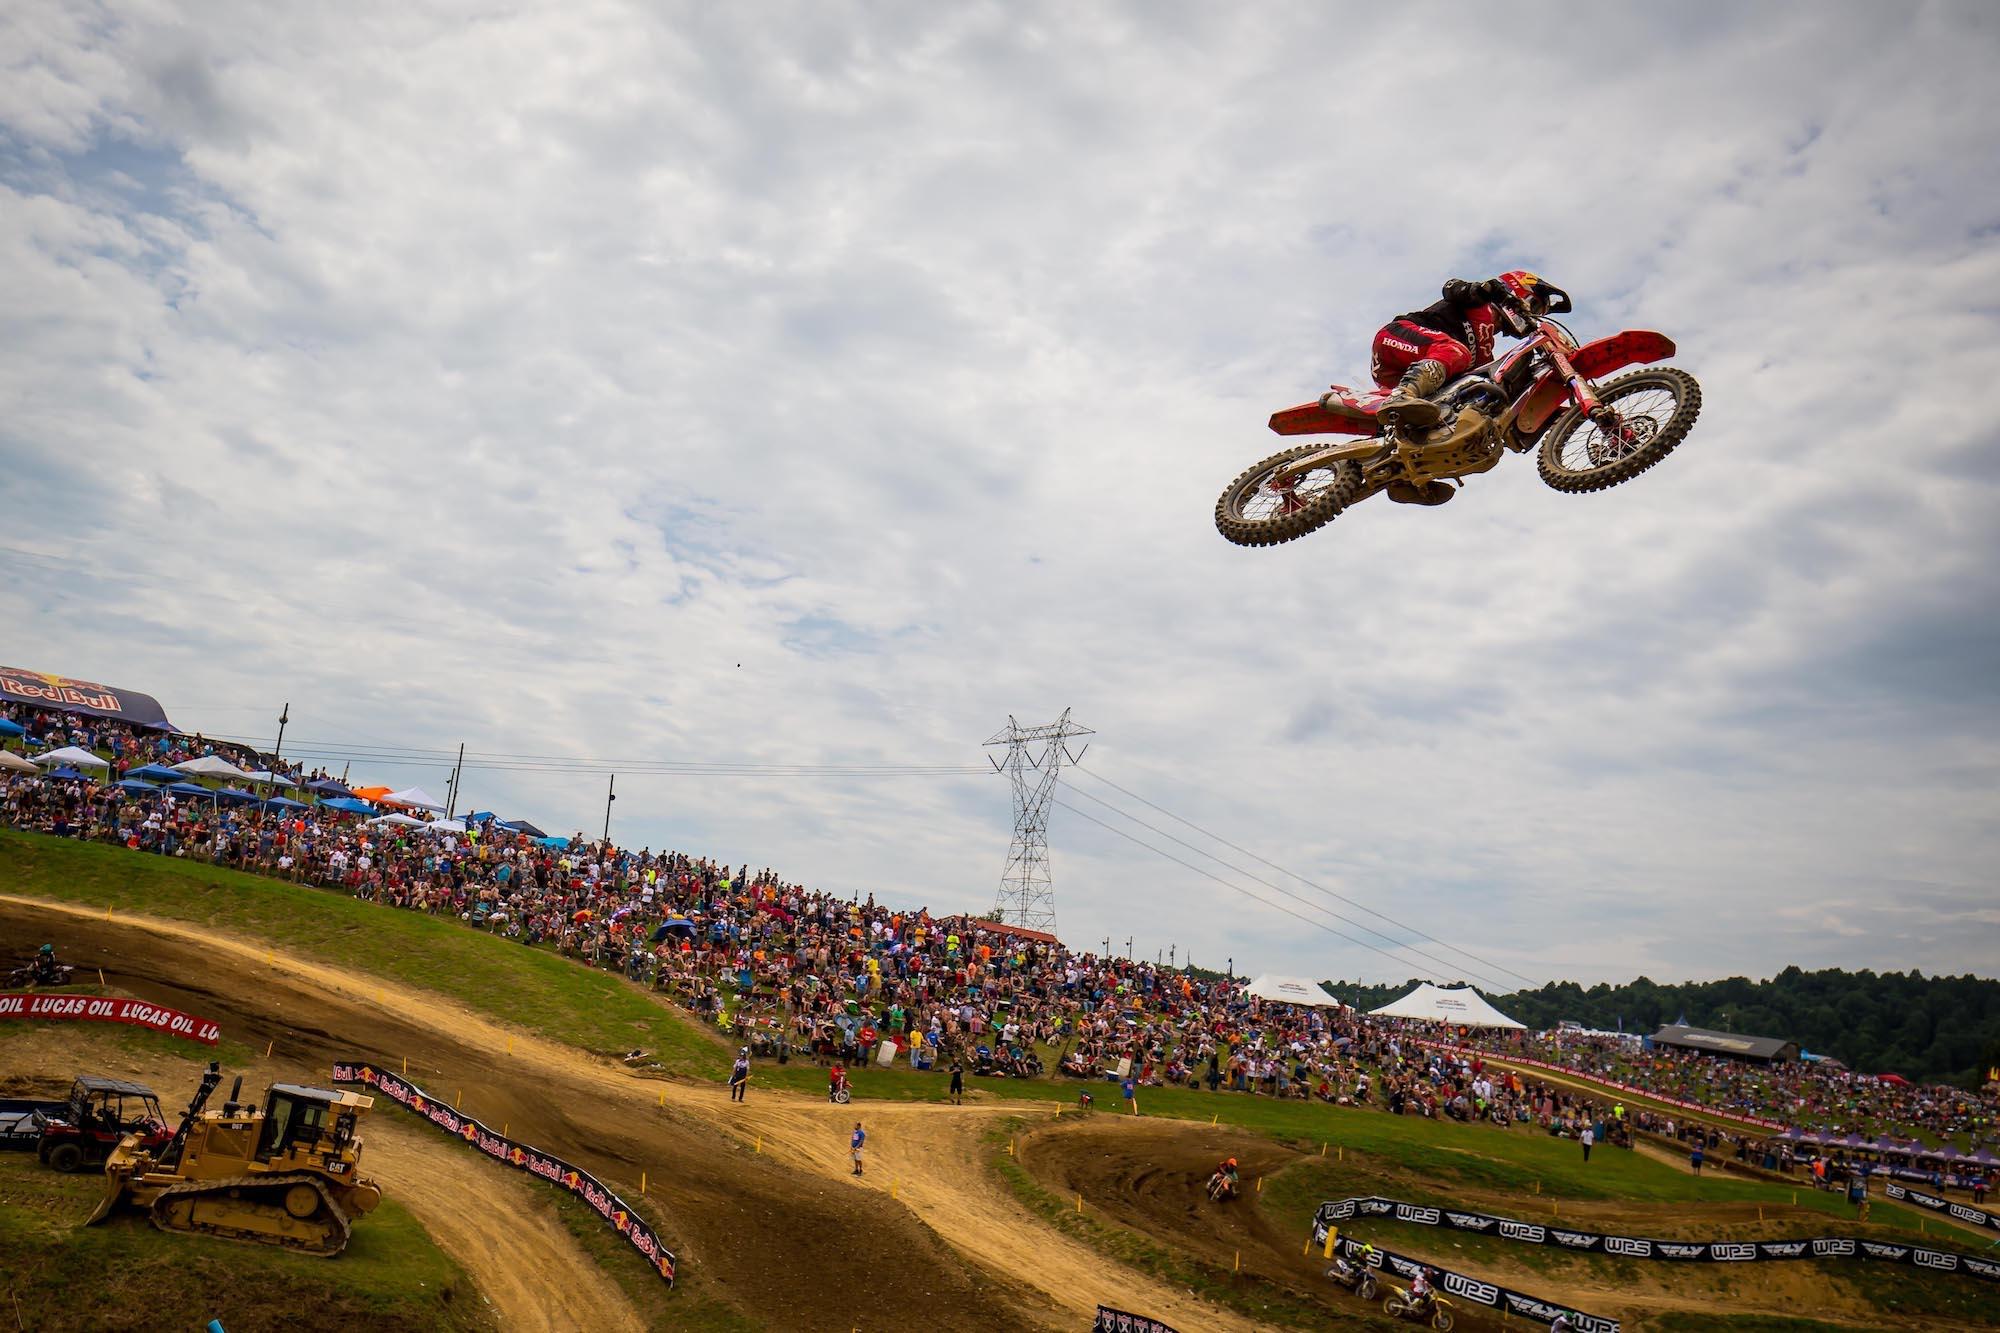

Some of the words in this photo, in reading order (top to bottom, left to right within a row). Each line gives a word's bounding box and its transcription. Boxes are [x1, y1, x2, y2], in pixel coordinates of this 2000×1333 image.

[1382, 337, 1419, 354] HONDA
[0, 678, 63, 702] Red
[62, 688, 122, 711] Bull
[0, 998, 23, 1013] OIL
[31, 998, 86, 1014] LUCAS
[88, 1001, 113, 1016] OIL
[120, 1003, 171, 1026] LUCAS
[171, 1016, 194, 1034] OIL
[198, 1024, 219, 1040] LU
[329, 1161, 345, 1174] CAT
[1950, 1203, 1986, 1225] WPS
[1325, 1201, 1356, 1220] WPS
[1396, 1203, 1440, 1225] WPS
[1446, 1213, 1495, 1229] FLY
[1500, 1220, 1545, 1243] WPS
[1551, 1230, 1600, 1247] FLY
[1605, 1236, 1651, 1257] WPS
[1657, 1244, 1706, 1256] FLY
[1711, 1243, 1757, 1261] WPS
[1761, 1242, 1807, 1255] FLY
[1812, 1239, 1856, 1256] WPS
[1861, 1242, 1909, 1258] FLY
[1914, 1249, 1958, 1271] WPS
[1444, 1272, 1499, 1306] WPS
[1505, 1292, 1564, 1319] FLY
